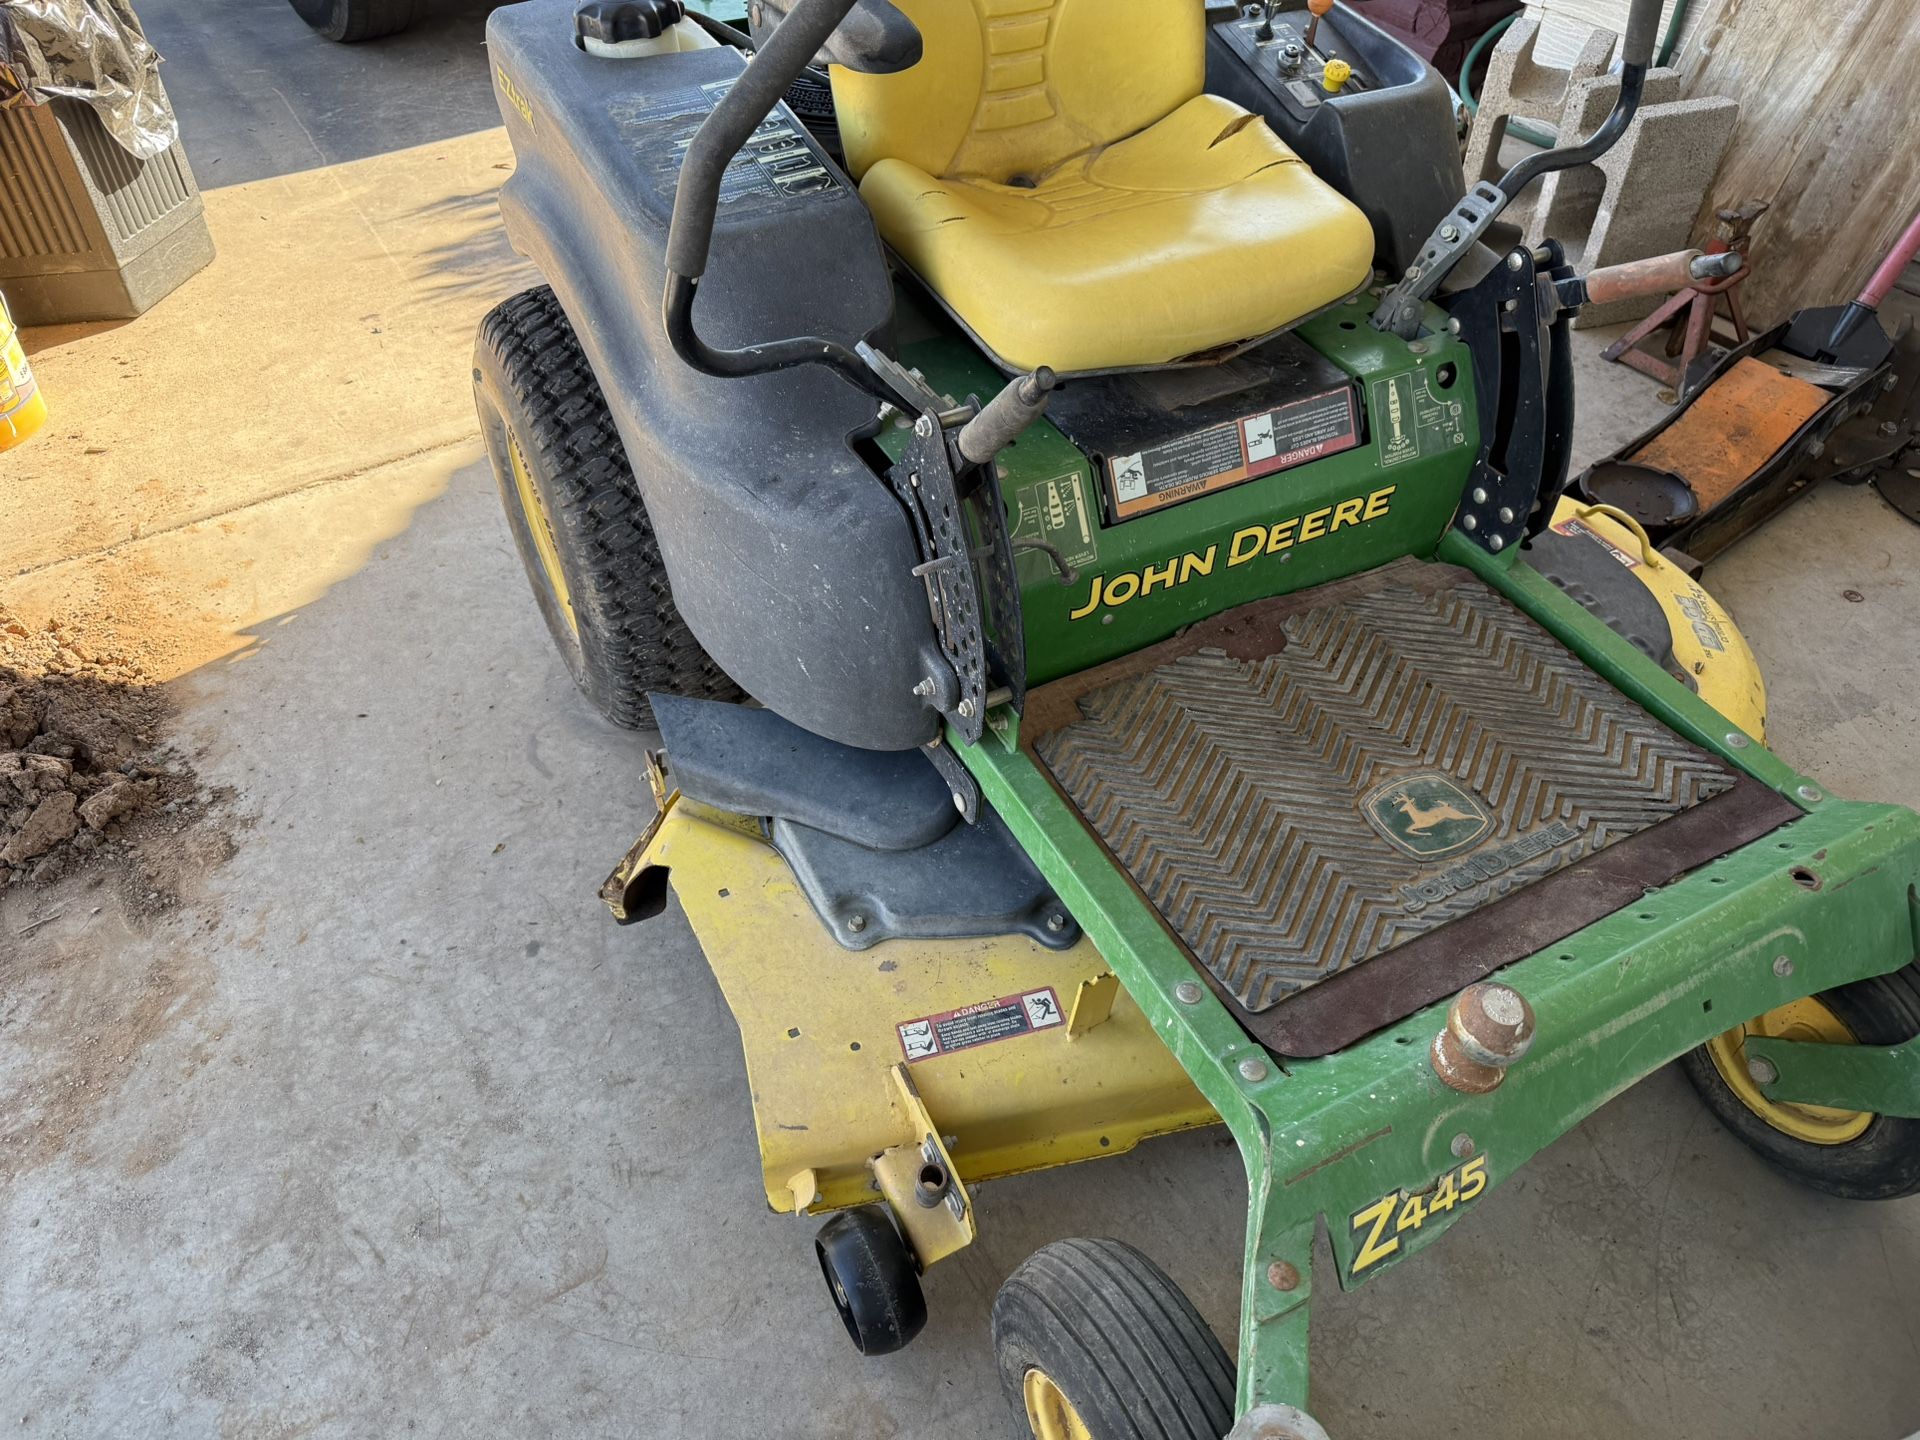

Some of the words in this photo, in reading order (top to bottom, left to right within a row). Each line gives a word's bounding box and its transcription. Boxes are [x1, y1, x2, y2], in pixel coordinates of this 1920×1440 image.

[1279, 445, 1315, 464] DANGER
[1158, 482, 1200, 501] WARNING
[1069, 544, 1218, 621] JOHN
[1226, 484, 1397, 568] DEERE
[1673, 593, 1724, 652] EDGE
[1399, 861, 1490, 912] JOHN
[1470, 821, 1580, 878] DEERE
[962, 1001, 1000, 1014] DANGER
[1351, 1155, 1487, 1274] Z445
